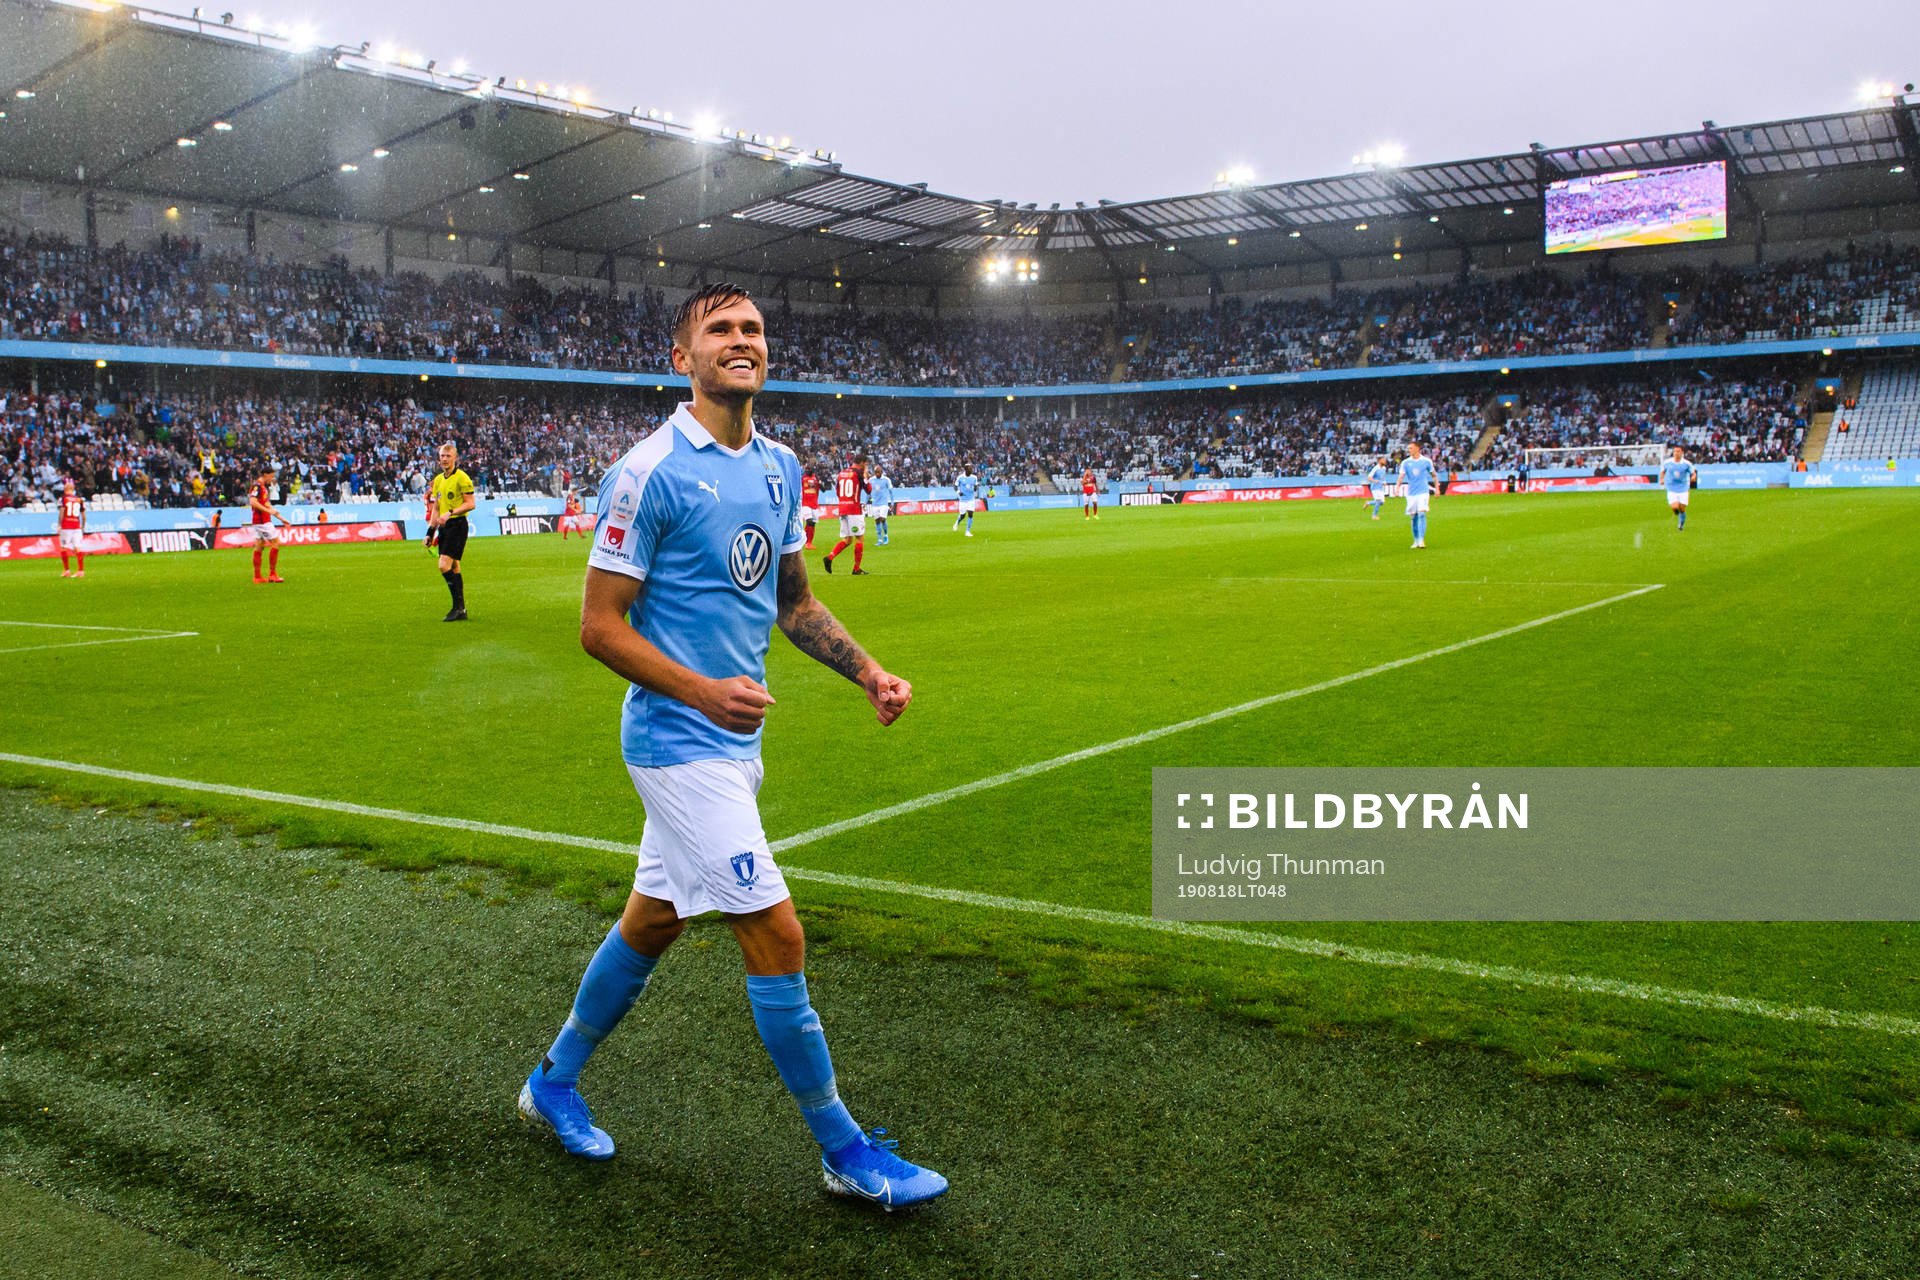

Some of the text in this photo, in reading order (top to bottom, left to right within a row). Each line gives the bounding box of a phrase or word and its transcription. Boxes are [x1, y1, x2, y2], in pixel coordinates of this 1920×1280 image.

[839, 479, 853, 498] 10
[1121, 493, 1162, 506] PUMA
[501, 517, 540, 536] PUMA
[140, 530, 191, 553] PUMA
